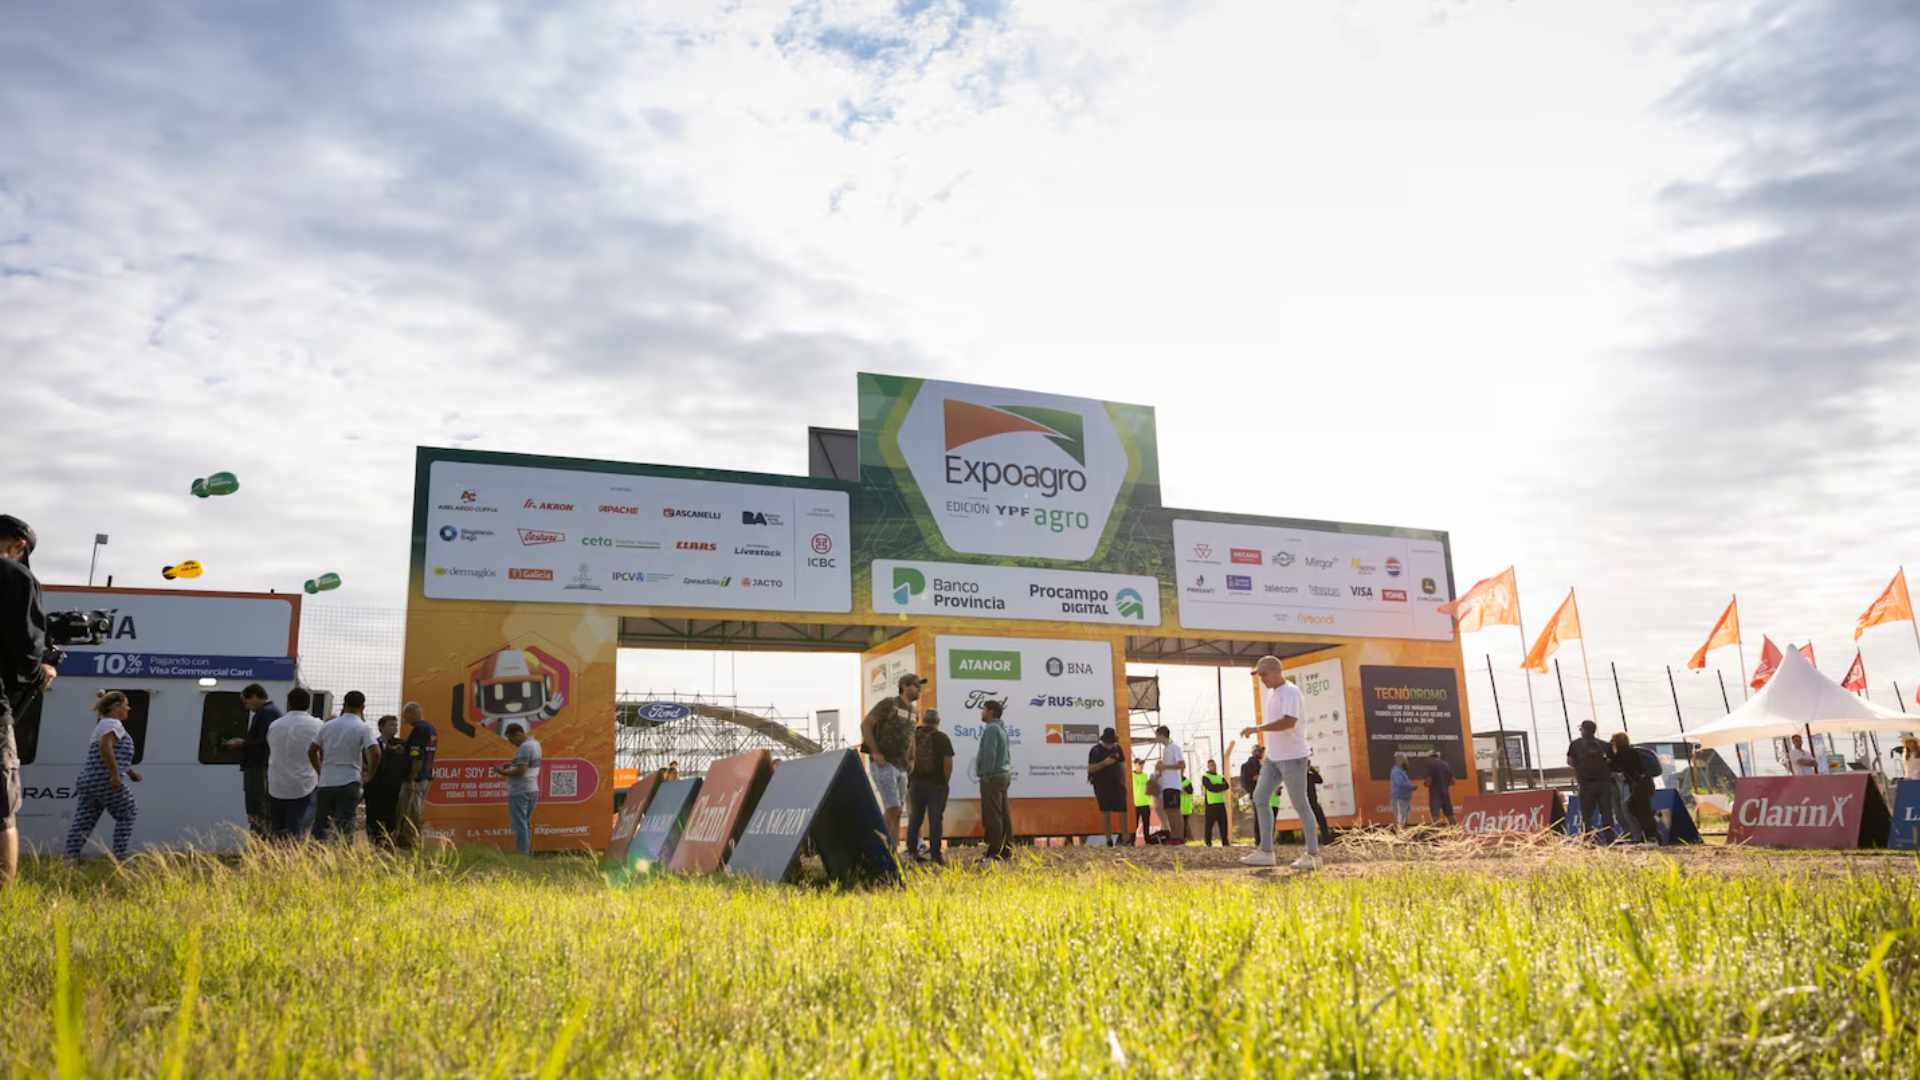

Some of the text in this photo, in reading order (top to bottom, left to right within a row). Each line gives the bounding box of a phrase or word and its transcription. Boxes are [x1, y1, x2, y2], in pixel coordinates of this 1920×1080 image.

[945, 455, 1087, 498] Expoagro
[539, 502, 576, 512] AKRON
[675, 509, 721, 521] ASCANELLI
[946, 499, 1090, 533] EDICIÓN YPF agro
[581, 535, 613, 548] ceta
[734, 546, 782, 558] Livestock
[807, 558, 837, 568] ICBC
[752, 579, 783, 588] JACTO
[933, 578, 979, 594] Banco
[1029, 584, 1109, 603] Procampo
[1350, 585, 1374, 597] VISA
[933, 594, 1006, 611] Provincia
[1062, 602, 1109, 615] DIGITAL
[149, 656, 209, 670] Pagando con
[959, 658, 1012, 673] ATANOR
[1067, 662, 1094, 675] BNA
[149, 665, 174, 676] Visa
[175, 665, 227, 677] Commercial
[1305, 680, 1331, 699] agro
[1048, 696, 1073, 708] RUS
[647, 705, 680, 718] Ford
[1739, 796, 1830, 828] Clarín
